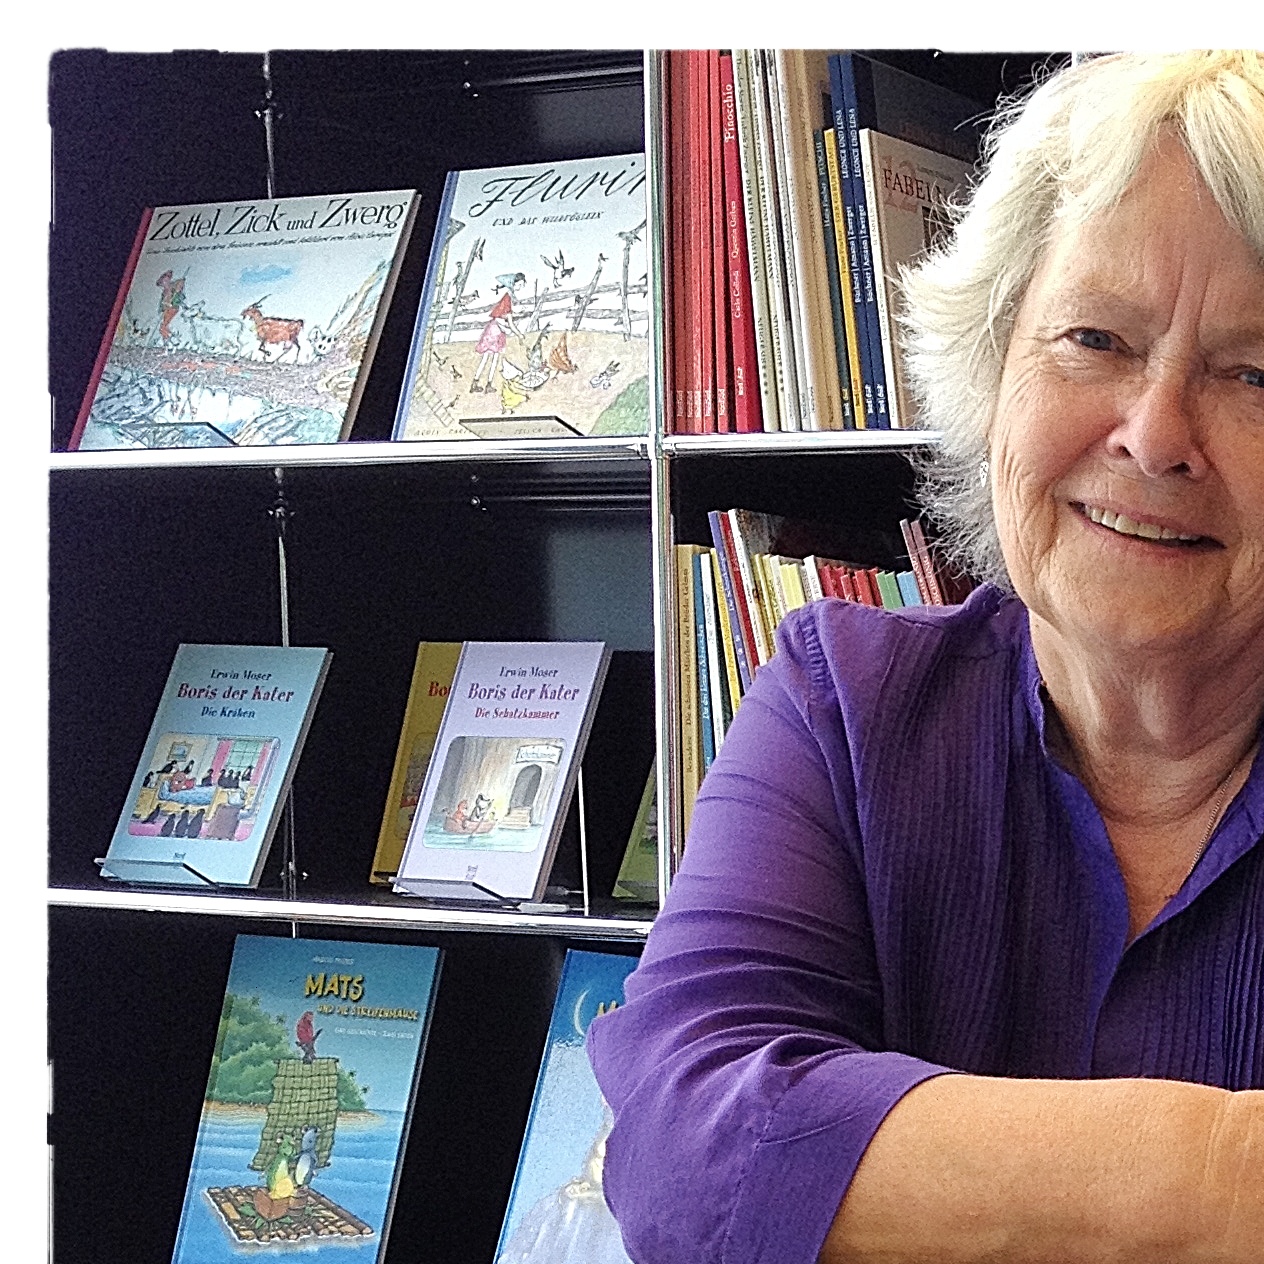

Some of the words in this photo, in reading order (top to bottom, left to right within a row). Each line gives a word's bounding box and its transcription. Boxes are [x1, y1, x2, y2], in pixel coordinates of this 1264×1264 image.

[723, 84, 735, 143] Pinocchio
[150, 209, 219, 242] Zottel,
[226, 201, 282, 233] Zick
[287, 212, 315, 230] und
[319, 197, 407, 228] Zwerg
[211, 669, 239, 680] Erwin
[242, 670, 271, 680] Moser
[499, 665, 524, 677] Erwin
[529, 666, 557, 678] Moser
[178, 683, 217, 699] Boris
[223, 686, 248, 700] der
[252, 685, 294, 702] Kater
[468, 682, 506, 700] Boris
[511, 684, 535, 700] der
[540, 683, 580, 703] Kater
[202, 707, 217, 716] Die
[475, 707, 491, 719] Die
[305, 972, 365, 1001] MATS
